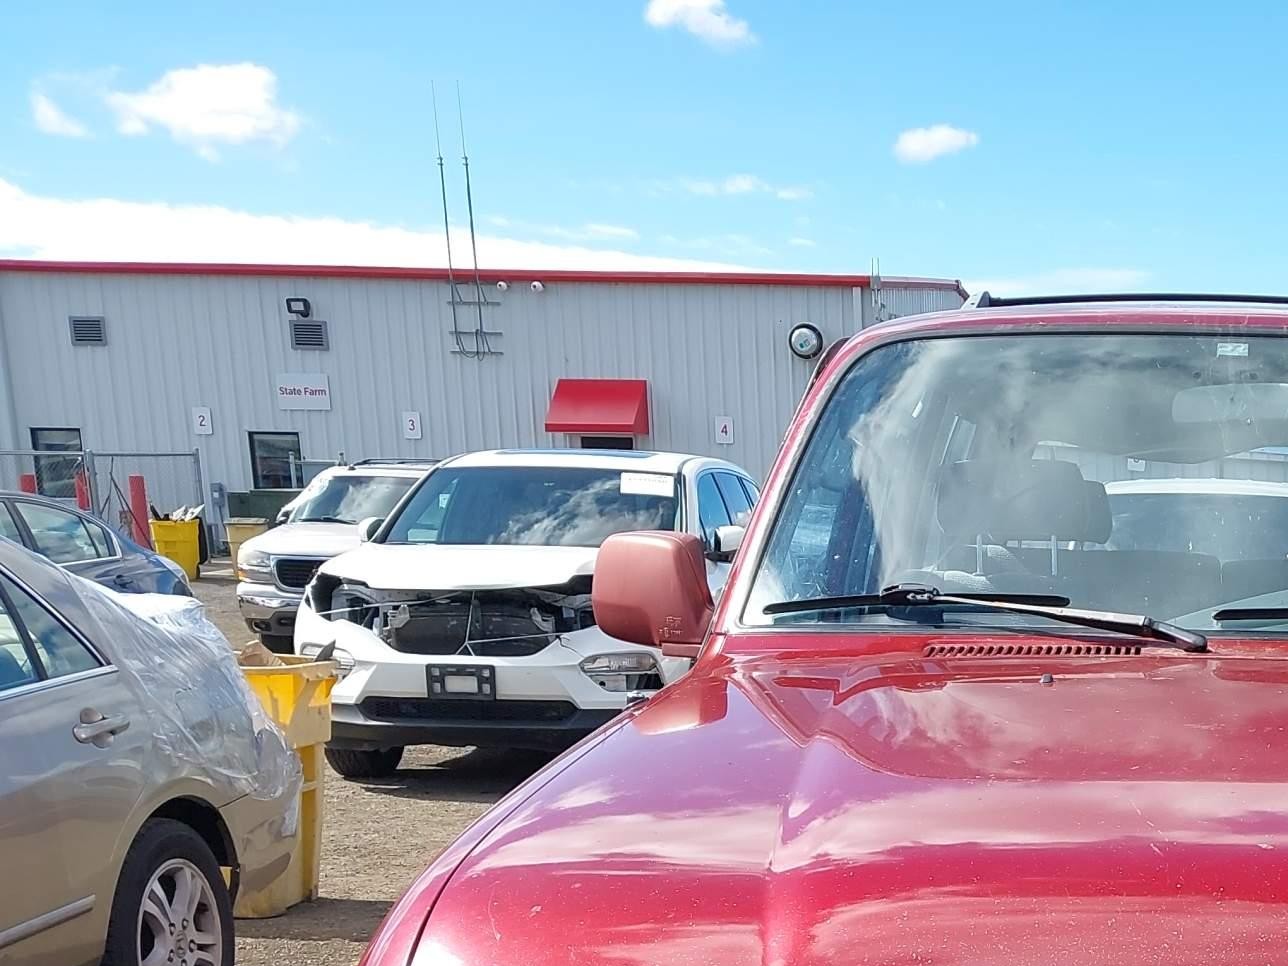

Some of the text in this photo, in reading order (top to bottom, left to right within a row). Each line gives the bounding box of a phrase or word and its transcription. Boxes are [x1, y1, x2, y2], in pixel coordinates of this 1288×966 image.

[279, 386, 327, 397] State Farm
[198, 415, 207, 427] 2
[408, 419, 416, 431] 3
[720, 424, 728, 437] 4
